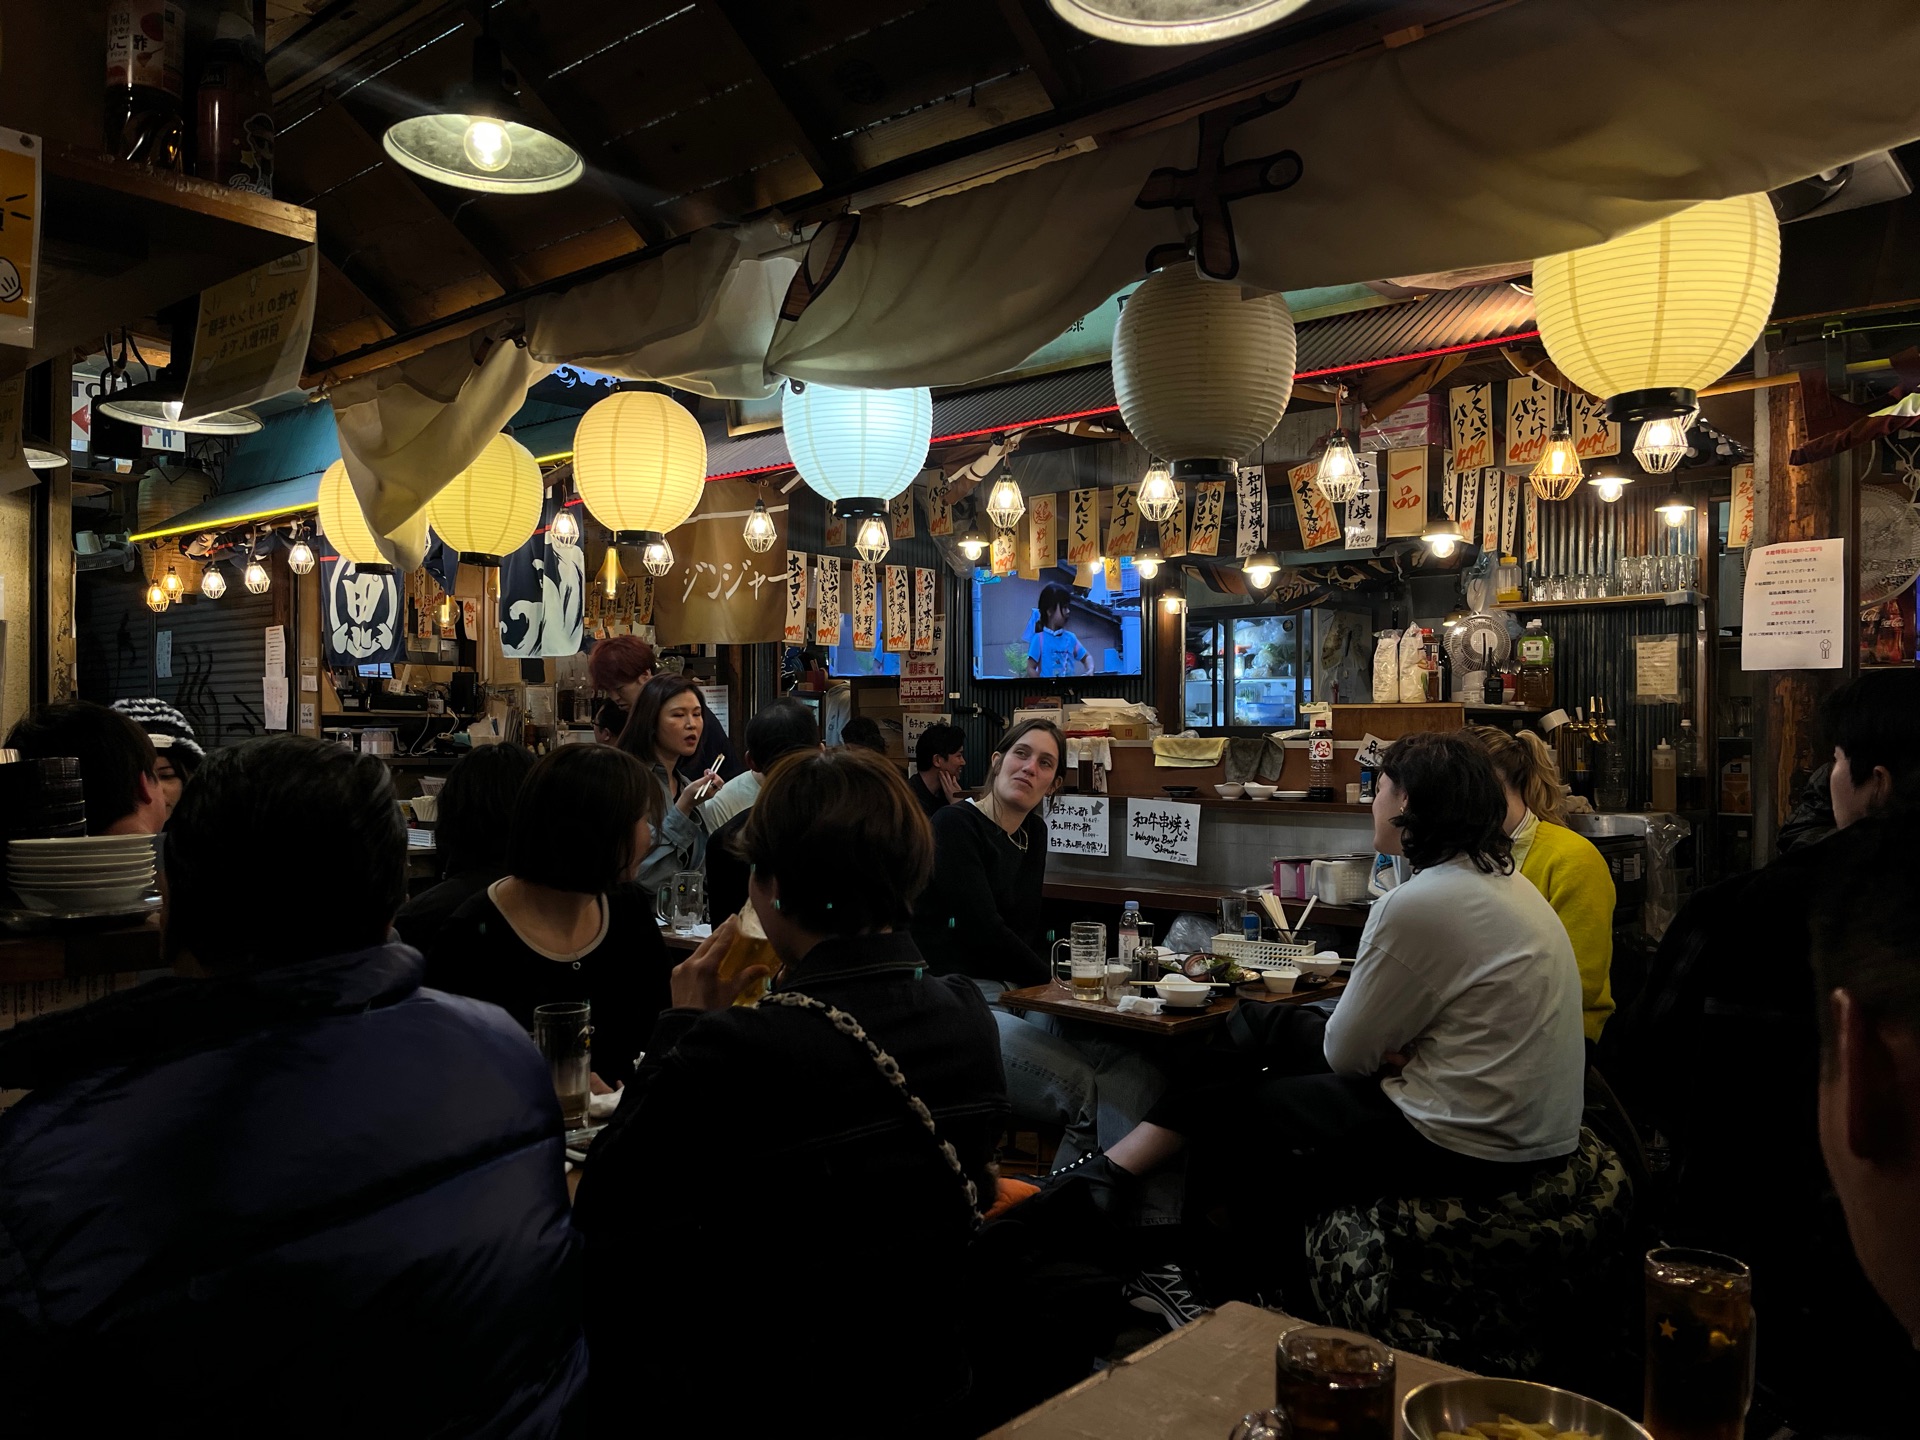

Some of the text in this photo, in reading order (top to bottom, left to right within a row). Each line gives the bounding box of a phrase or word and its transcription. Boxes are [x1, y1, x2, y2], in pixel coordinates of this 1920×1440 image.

[1466, 384, 1488, 443] アスパラ
[1511, 397, 1531, 439] バター
[1531, 377, 1548, 443] しいたけ
[1113, 485, 1137, 531] なす
[1246, 471, 1265, 543] 和牛串焼き
[1391, 465, 1422, 510] 一品
[1075, 490, 1093, 542] にんにく
[682, 559, 788, 604] ジンジャー
[1132, 811, 1191, 836] 和牛串焼き
